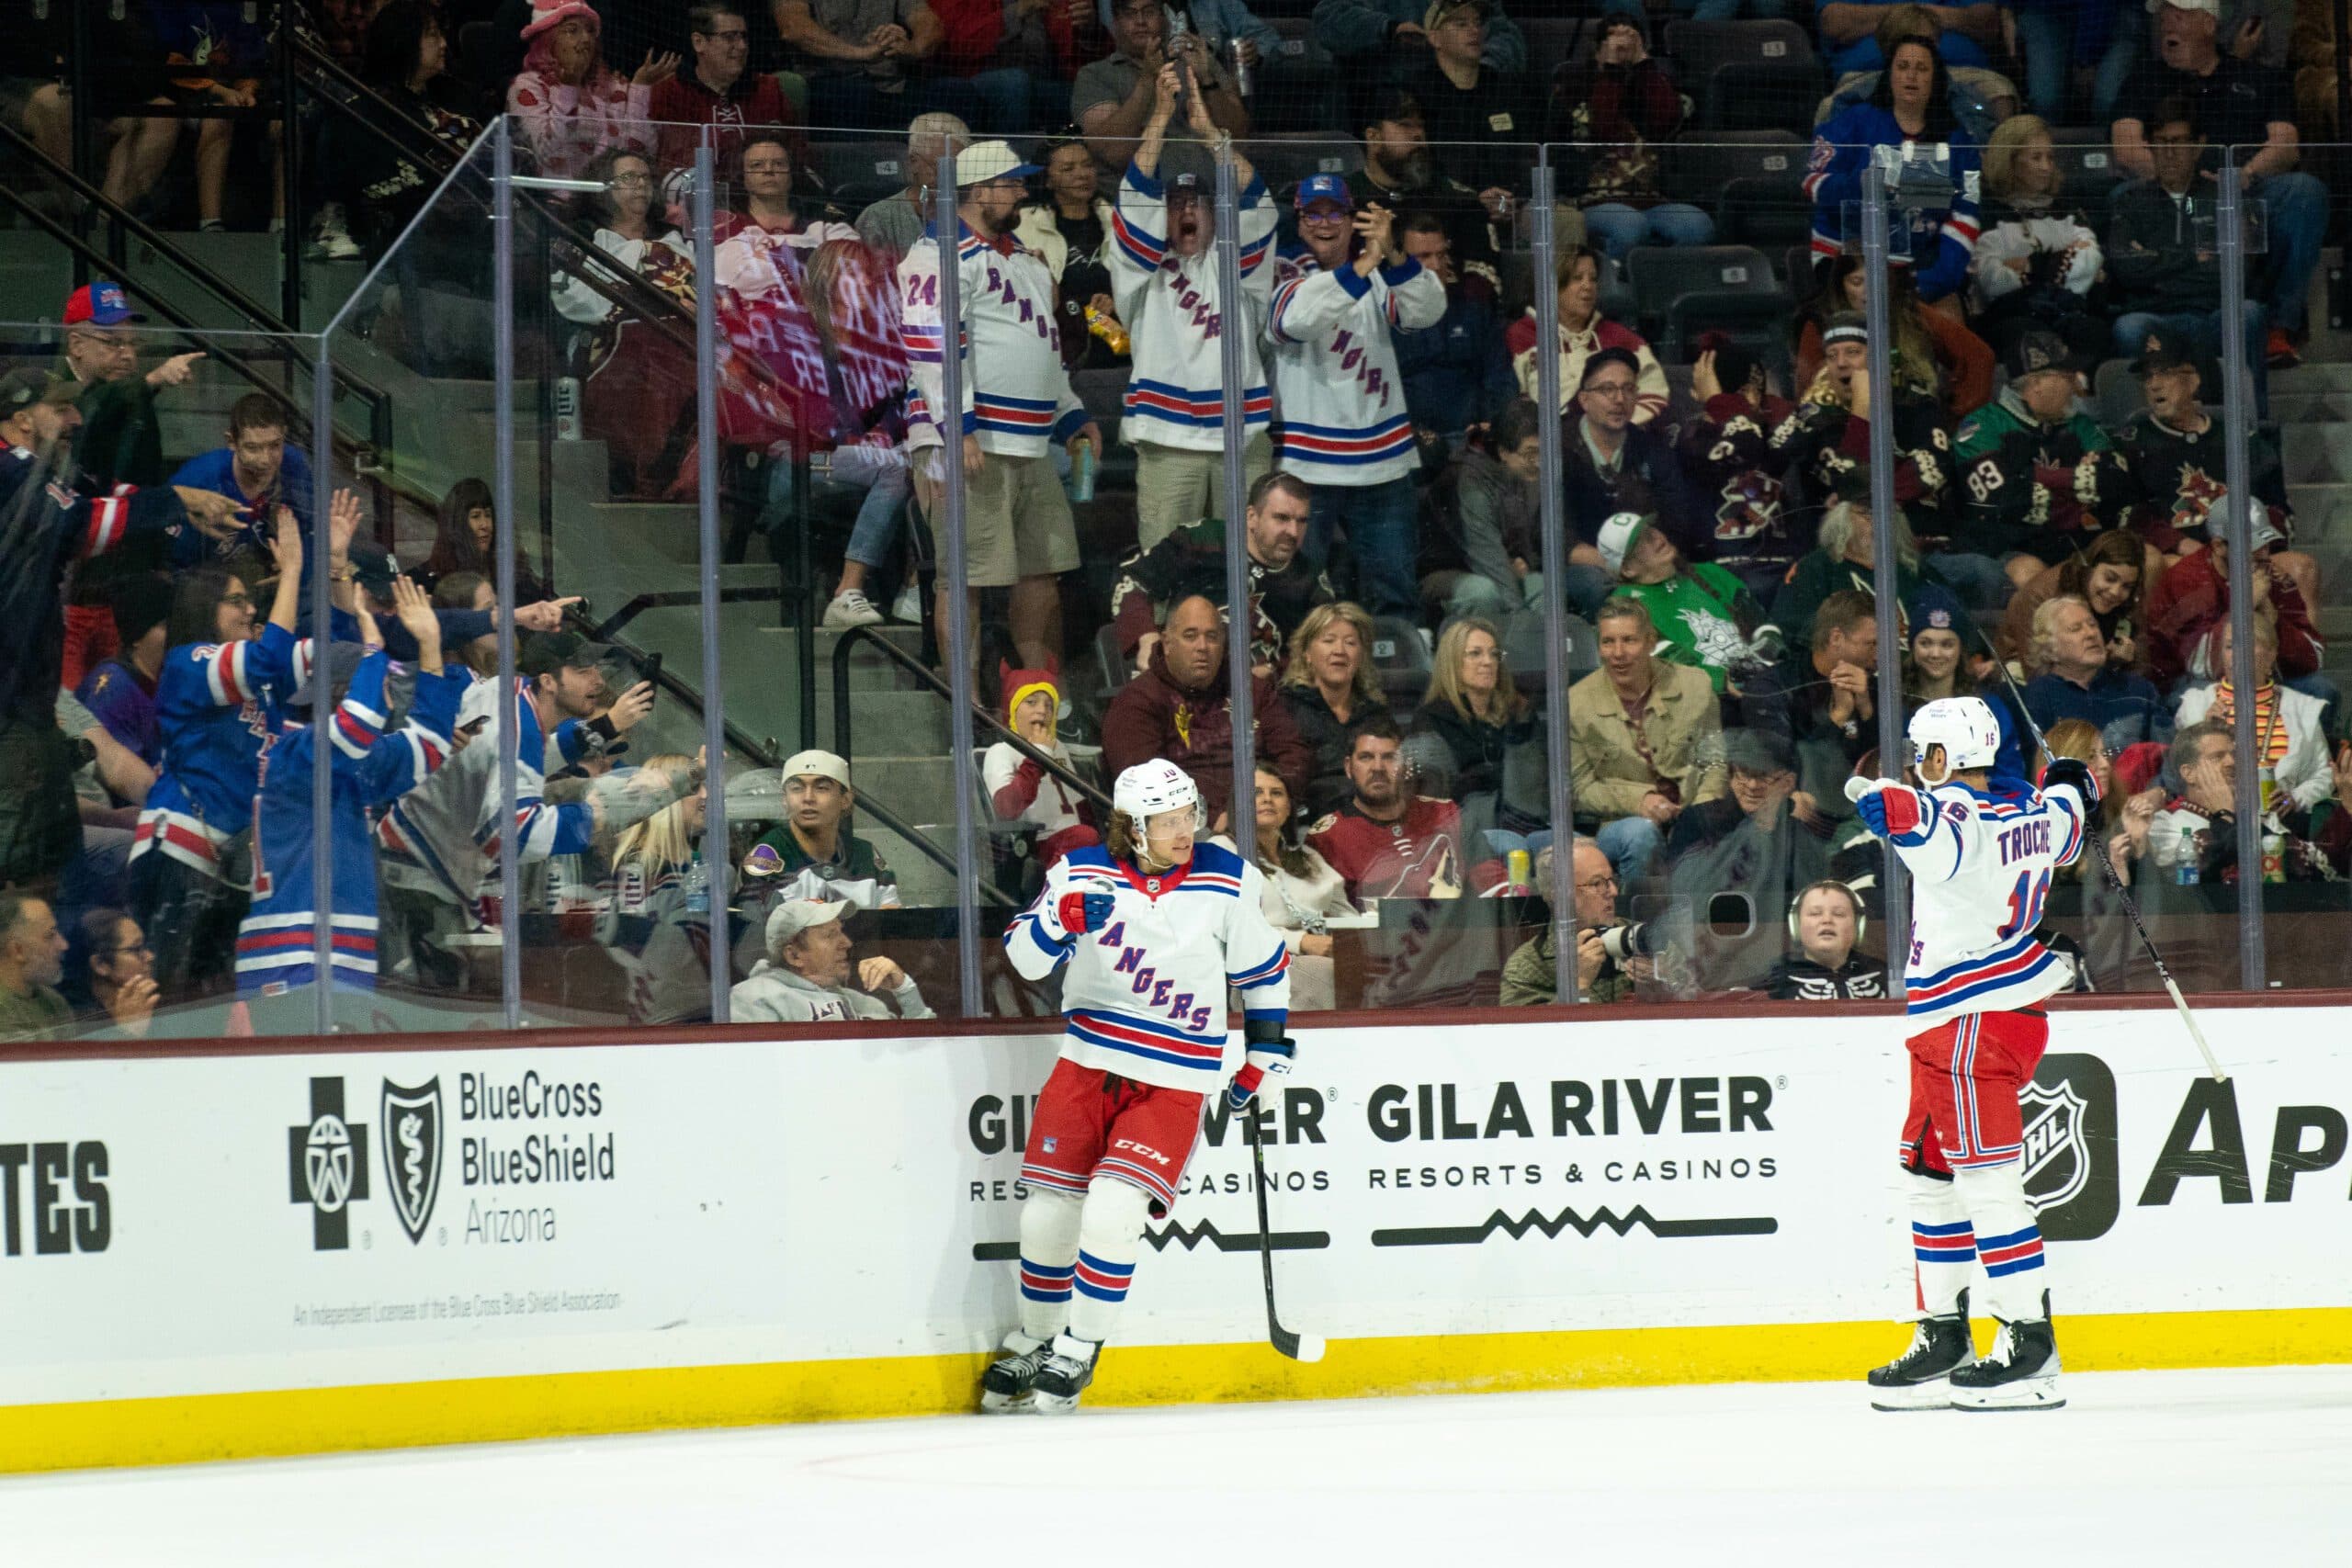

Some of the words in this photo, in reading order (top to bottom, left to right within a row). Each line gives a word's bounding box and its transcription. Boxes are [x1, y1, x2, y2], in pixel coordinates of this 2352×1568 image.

[908, 274, 936, 297] 24
[1985, 732, 1996, 747] 16
[1169, 786, 1188, 796] CCM
[1097, 904, 1212, 1032] ANGERS
[459, 1070, 603, 1121] BlueCross
[1367, 1081, 1534, 1143] GILA
[1550, 1076, 1774, 1137] RIVER
[461, 1132, 615, 1186] BlueShield
[1114, 1138, 1170, 1167] CCM
[1369, 1164, 1543, 1189] RESORTS
[1565, 1163, 1584, 1183] &
[1604, 1157, 1778, 1183] CASINOS
[464, 1198, 557, 1245] Arizona
[310, 1302, 370, 1329] Independent
[372, 1299, 416, 1323] Licensee
[419, 1296, 429, 1320] of
[448, 1294, 471, 1317] Blue
[473, 1293, 501, 1316] Cross
[503, 1292, 525, 1314] Blue
[527, 1290, 559, 1314] Shield
